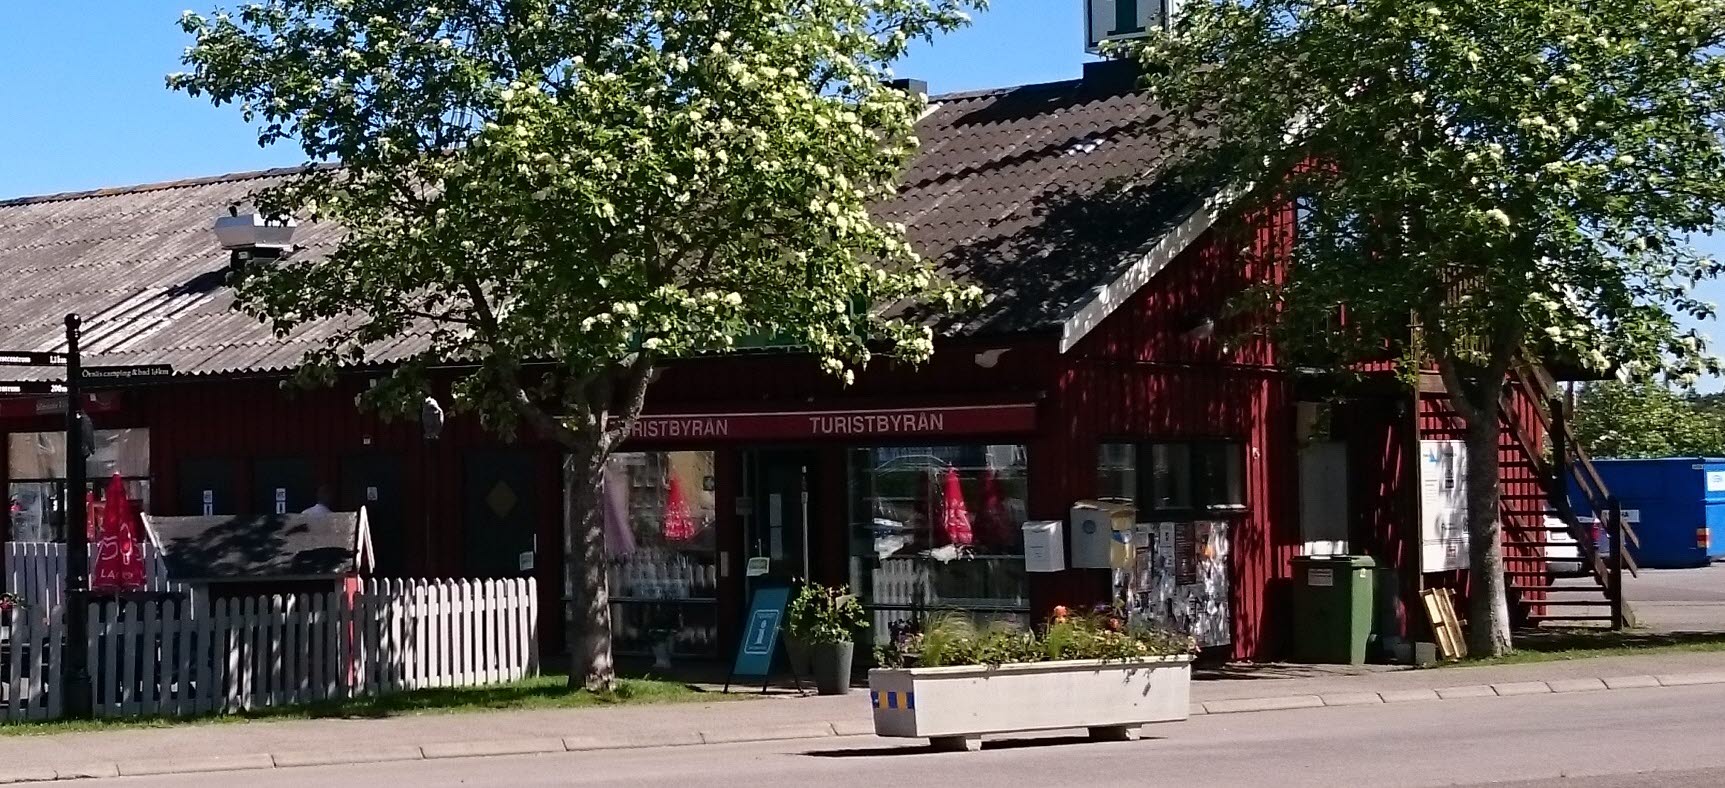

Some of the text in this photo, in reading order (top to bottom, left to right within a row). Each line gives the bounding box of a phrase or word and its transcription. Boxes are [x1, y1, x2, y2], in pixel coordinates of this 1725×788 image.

[103, 369, 132, 379] camping
[612, 418, 728, 437] RISTBYRÅN
[809, 412, 944, 434] TURISTBYRÅN
